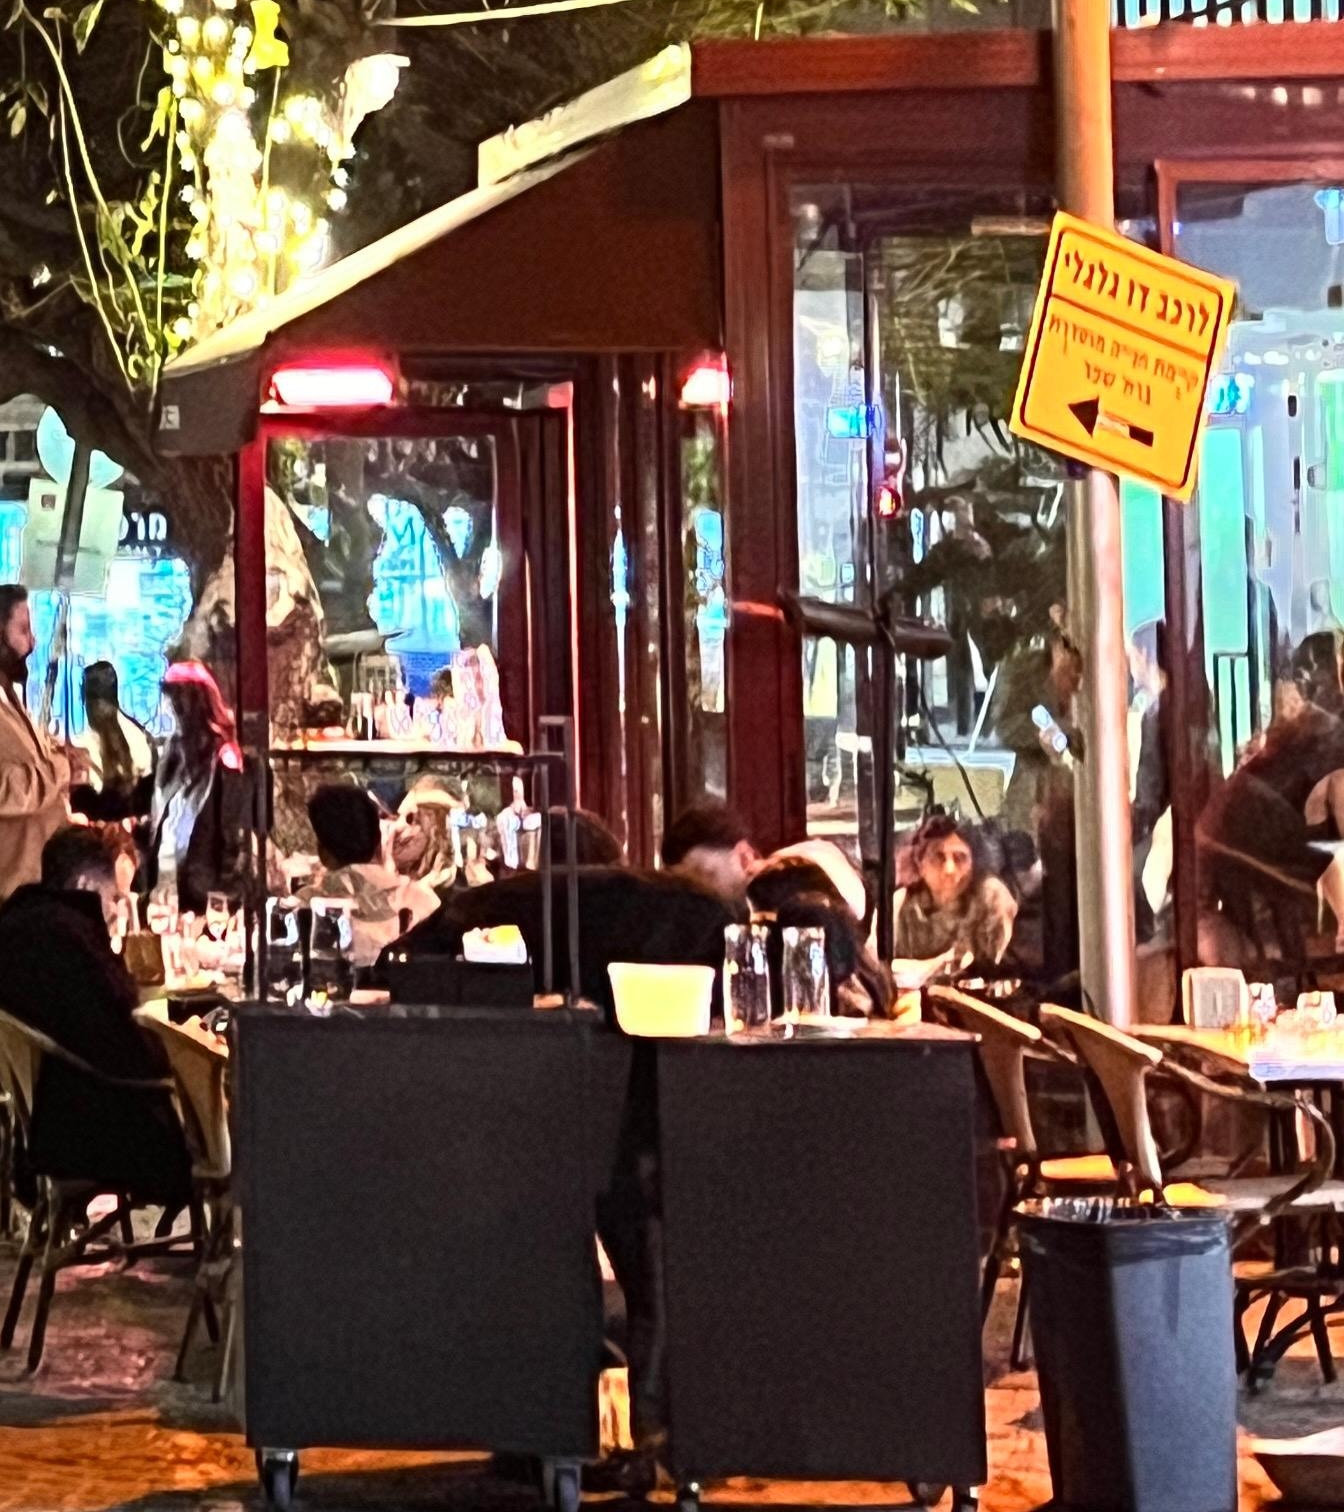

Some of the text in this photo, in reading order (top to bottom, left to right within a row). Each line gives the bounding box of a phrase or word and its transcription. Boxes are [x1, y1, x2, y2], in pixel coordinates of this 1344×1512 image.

[1064, 249, 1210, 337] לרכב דו גלגלי
